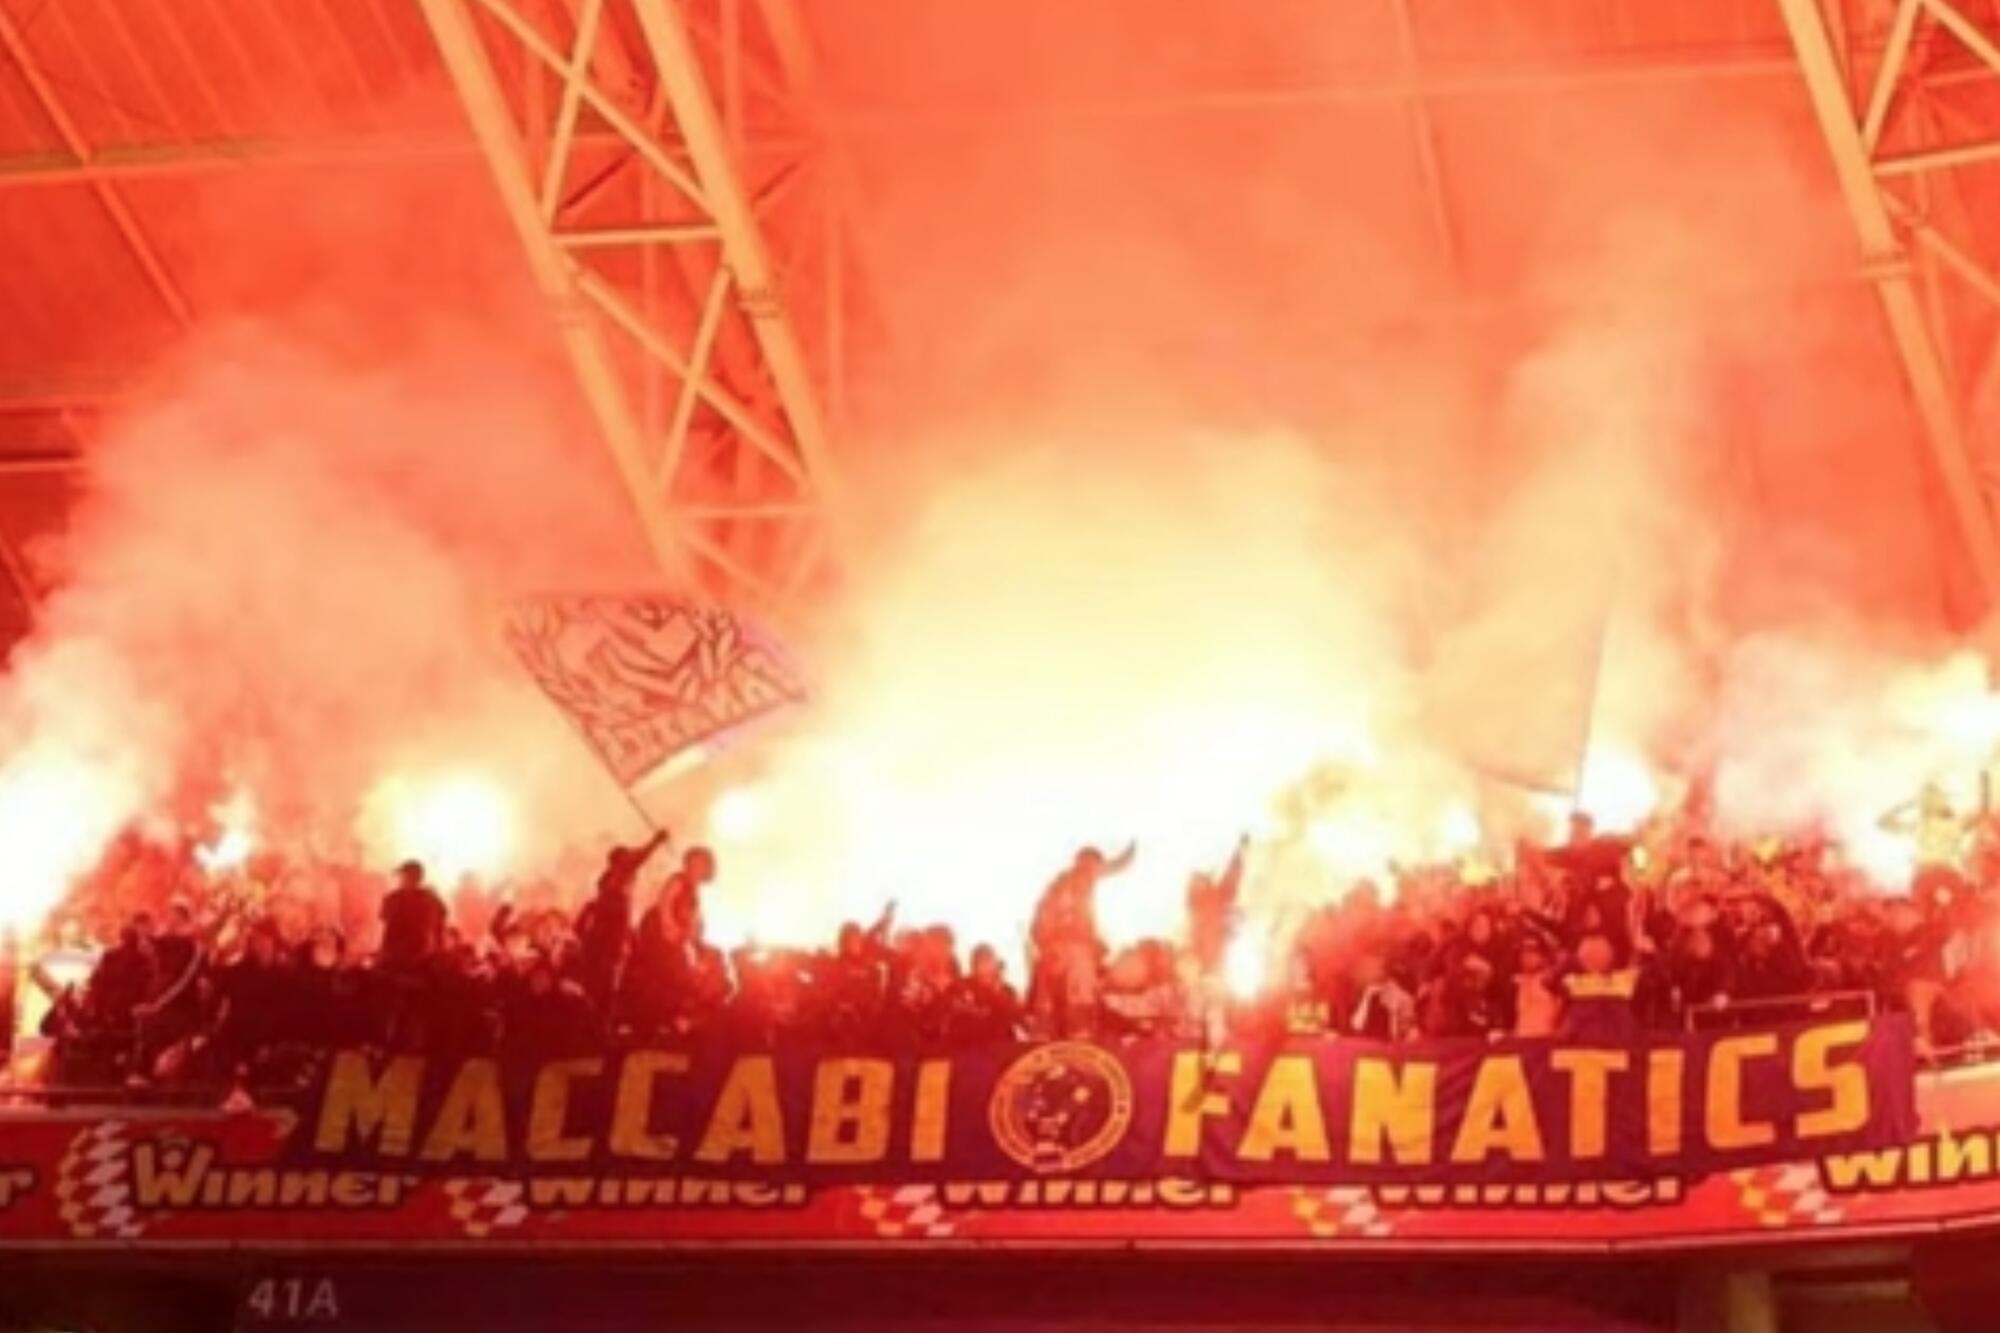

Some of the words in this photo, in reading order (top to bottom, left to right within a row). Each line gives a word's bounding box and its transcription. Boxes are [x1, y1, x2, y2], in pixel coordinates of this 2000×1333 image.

[315, 1050, 952, 1164] MACCABI
[1163, 1020, 1870, 1165] FANATICS
[1824, 1132, 2000, 1189] Win
[248, 1278, 341, 1319] 41A
